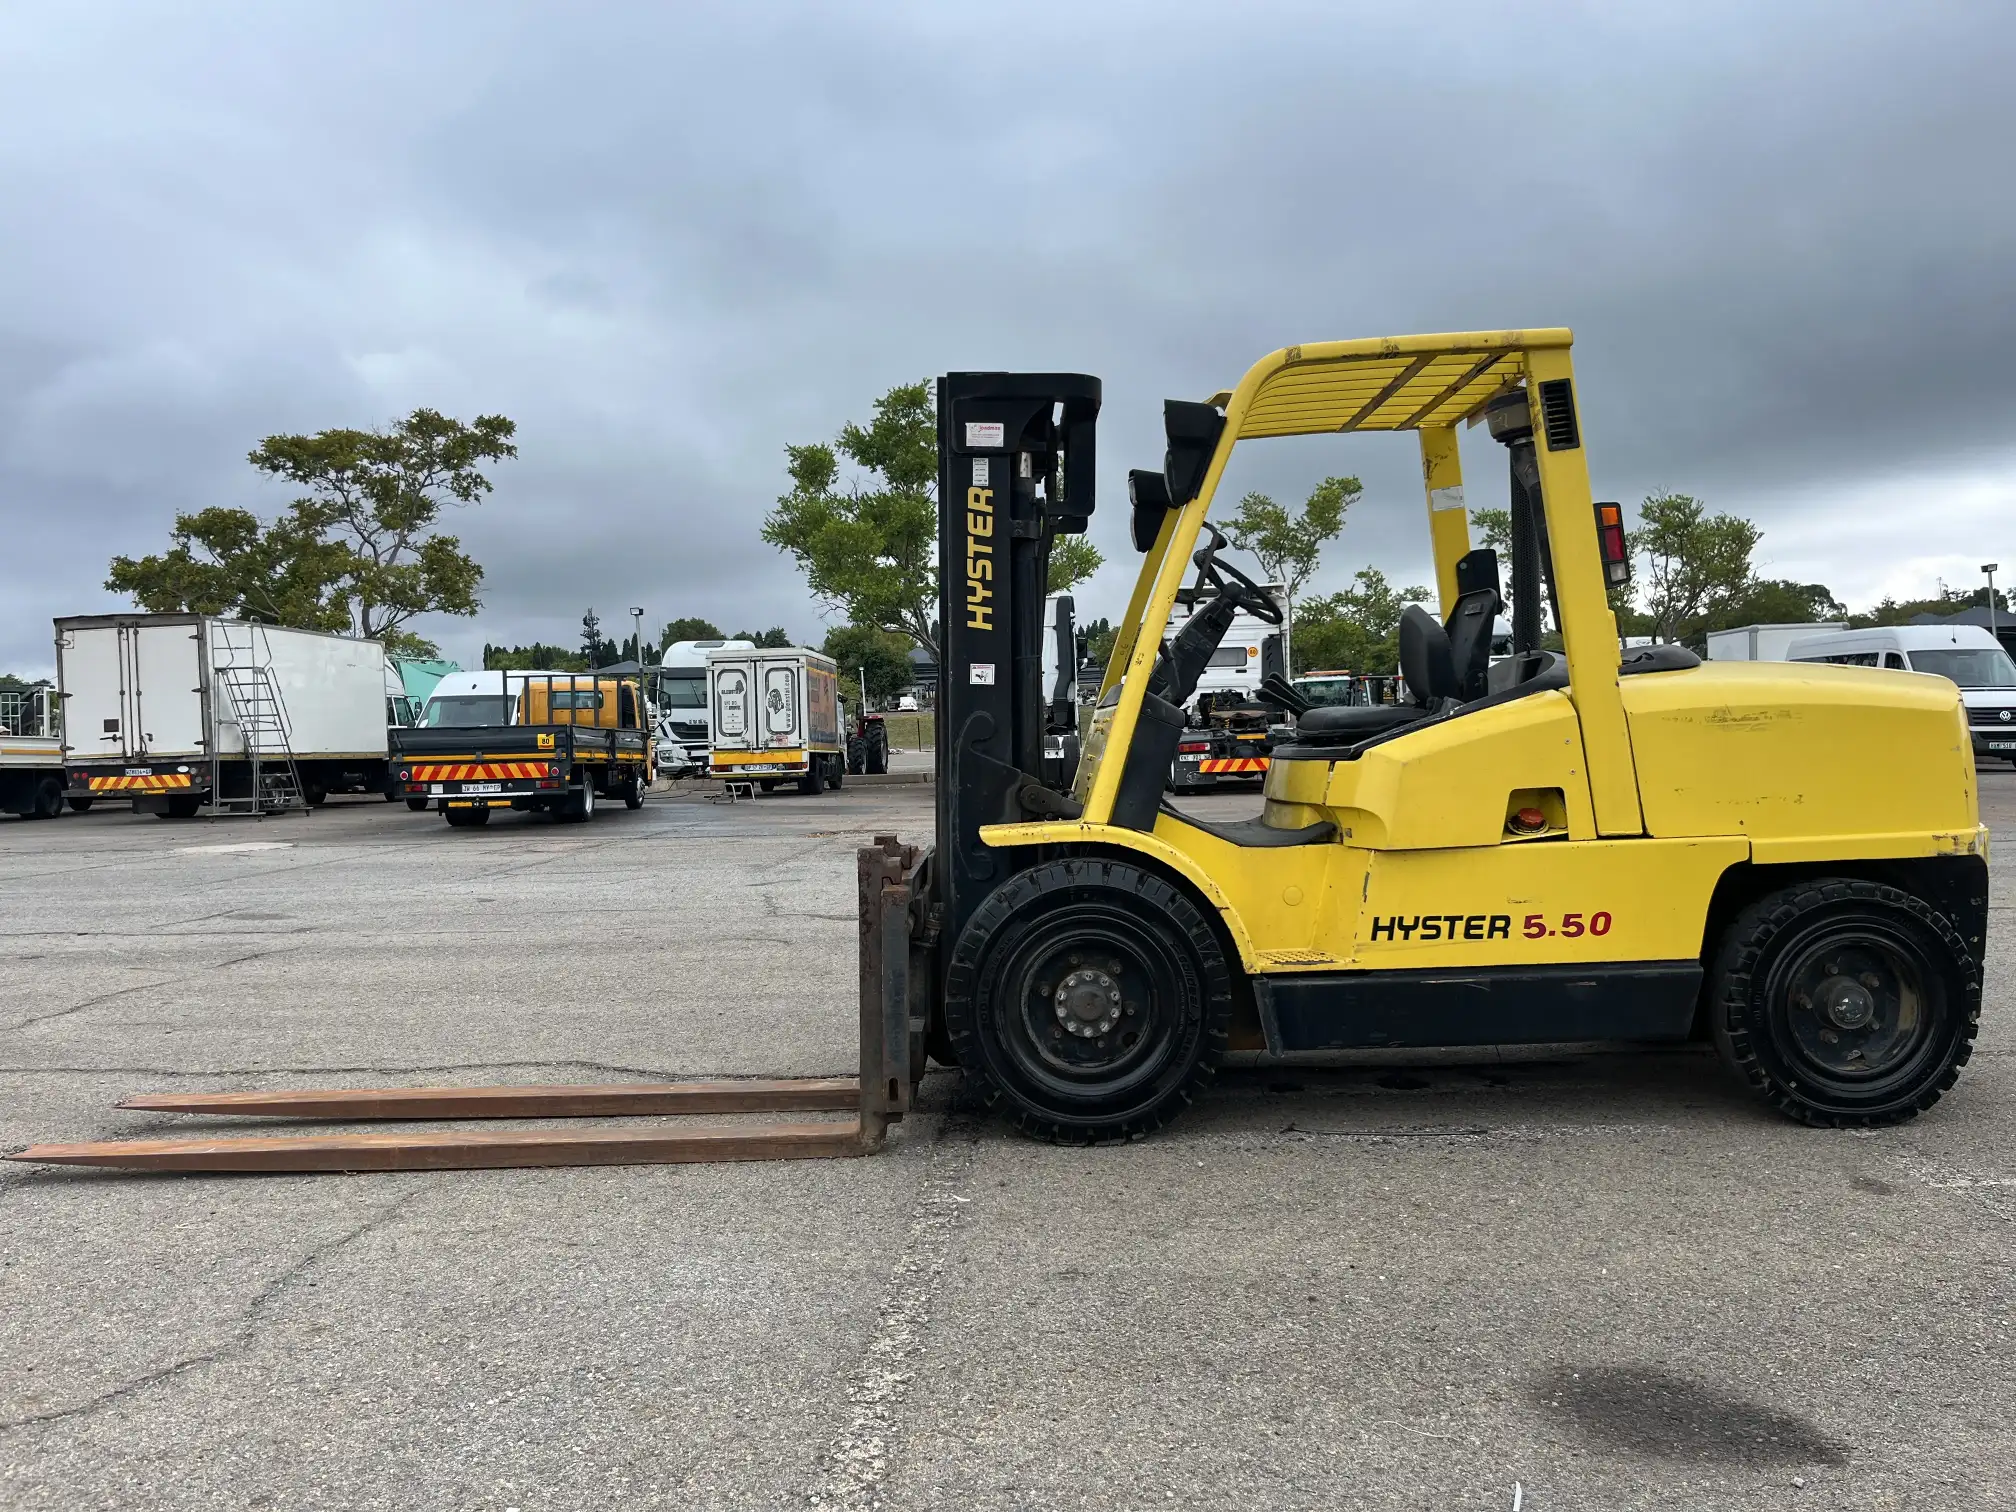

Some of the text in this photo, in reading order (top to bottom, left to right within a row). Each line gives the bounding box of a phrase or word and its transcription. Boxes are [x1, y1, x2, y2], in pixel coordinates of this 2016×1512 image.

[967, 486, 993, 631] HYSTER
[1370, 911, 1613, 941] HYSTER 5.50
